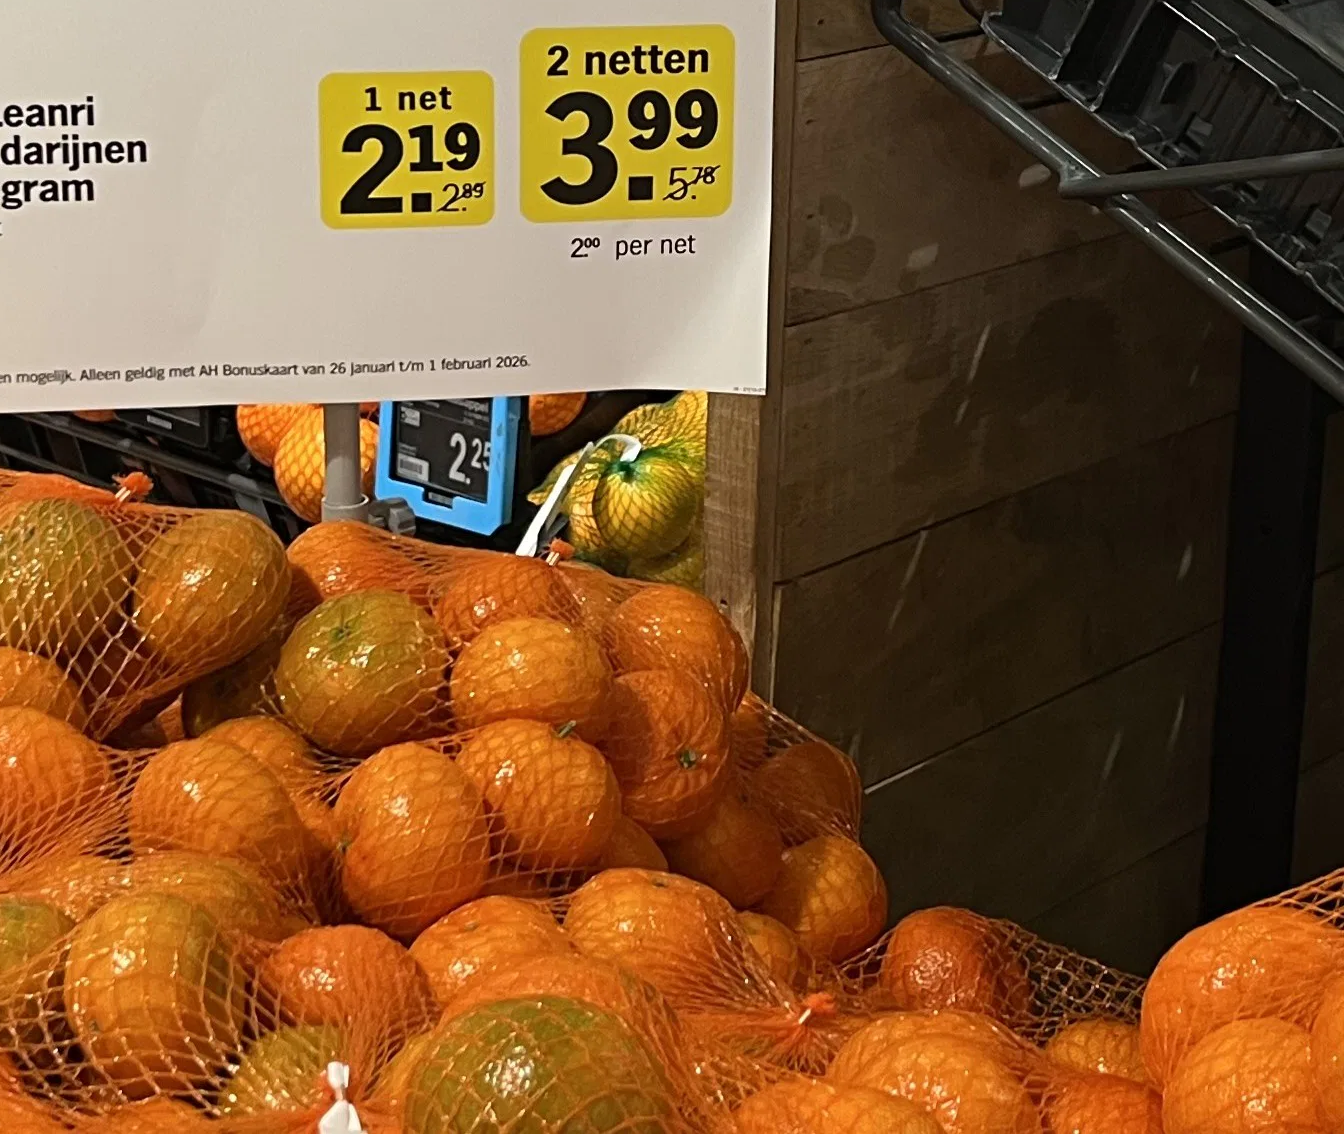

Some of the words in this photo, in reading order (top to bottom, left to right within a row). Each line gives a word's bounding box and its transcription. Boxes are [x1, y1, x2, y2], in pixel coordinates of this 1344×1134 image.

[546, 46, 569, 76] 2
[585, 44, 709, 75] netten
[364, 86, 382, 112] 1
[398, 86, 452, 111] net
[539, 89, 719, 205] 3.99
[340, 122, 481, 214] 2.19
[1, 179, 94, 210] gram
[570, 237, 601, 258] 2.00
[615, 239, 653, 261] per
[659, 234, 696, 255] net
[79, 368, 121, 382] Alleen
[125, 366, 165, 382] geldig
[169, 365, 195, 378] met
[199, 364, 219, 377] AH
[223, 363, 299, 376] Bonuskaart
[302, 365, 325, 376] van
[330, 362, 346, 375] 26
[350, 360, 394, 377] januari
[399, 359, 425, 373] t/m
[429, 359, 436, 371] 1
[441, 357, 492, 371] februari
[495, 355, 531, 368] 2026.
[449, 432, 492, 485] 2.25
